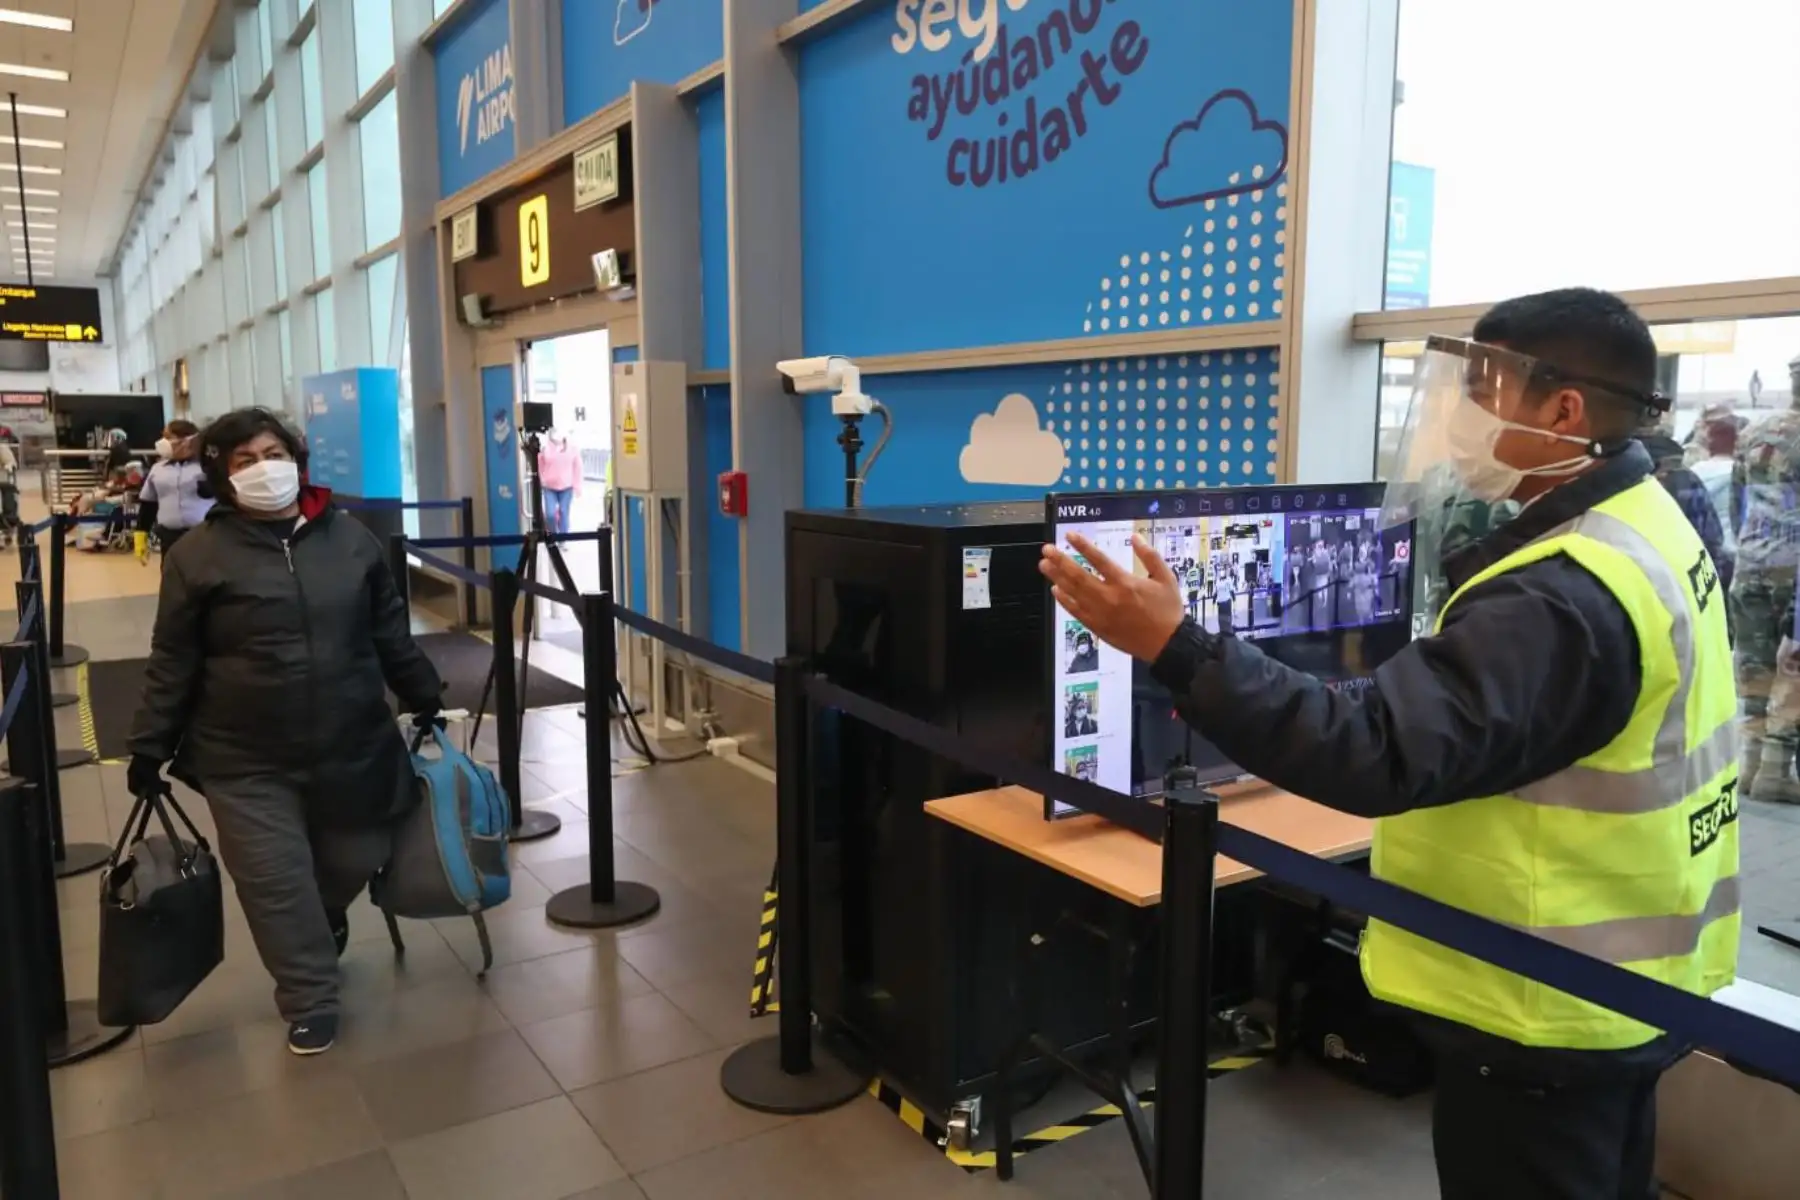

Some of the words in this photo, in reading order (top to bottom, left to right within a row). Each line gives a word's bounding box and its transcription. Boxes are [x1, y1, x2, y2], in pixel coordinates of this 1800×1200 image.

[891, 0, 1028, 63] seg
[476, 43, 513, 103] LIMA
[908, 0, 1116, 141] ayúdano
[947, 20, 1149, 187] cuidarte
[577, 148, 613, 196] SALIDA
[529, 211, 540, 273] 9
[575, 406, 586, 421] H
[1058, 505, 1087, 517] NVR
